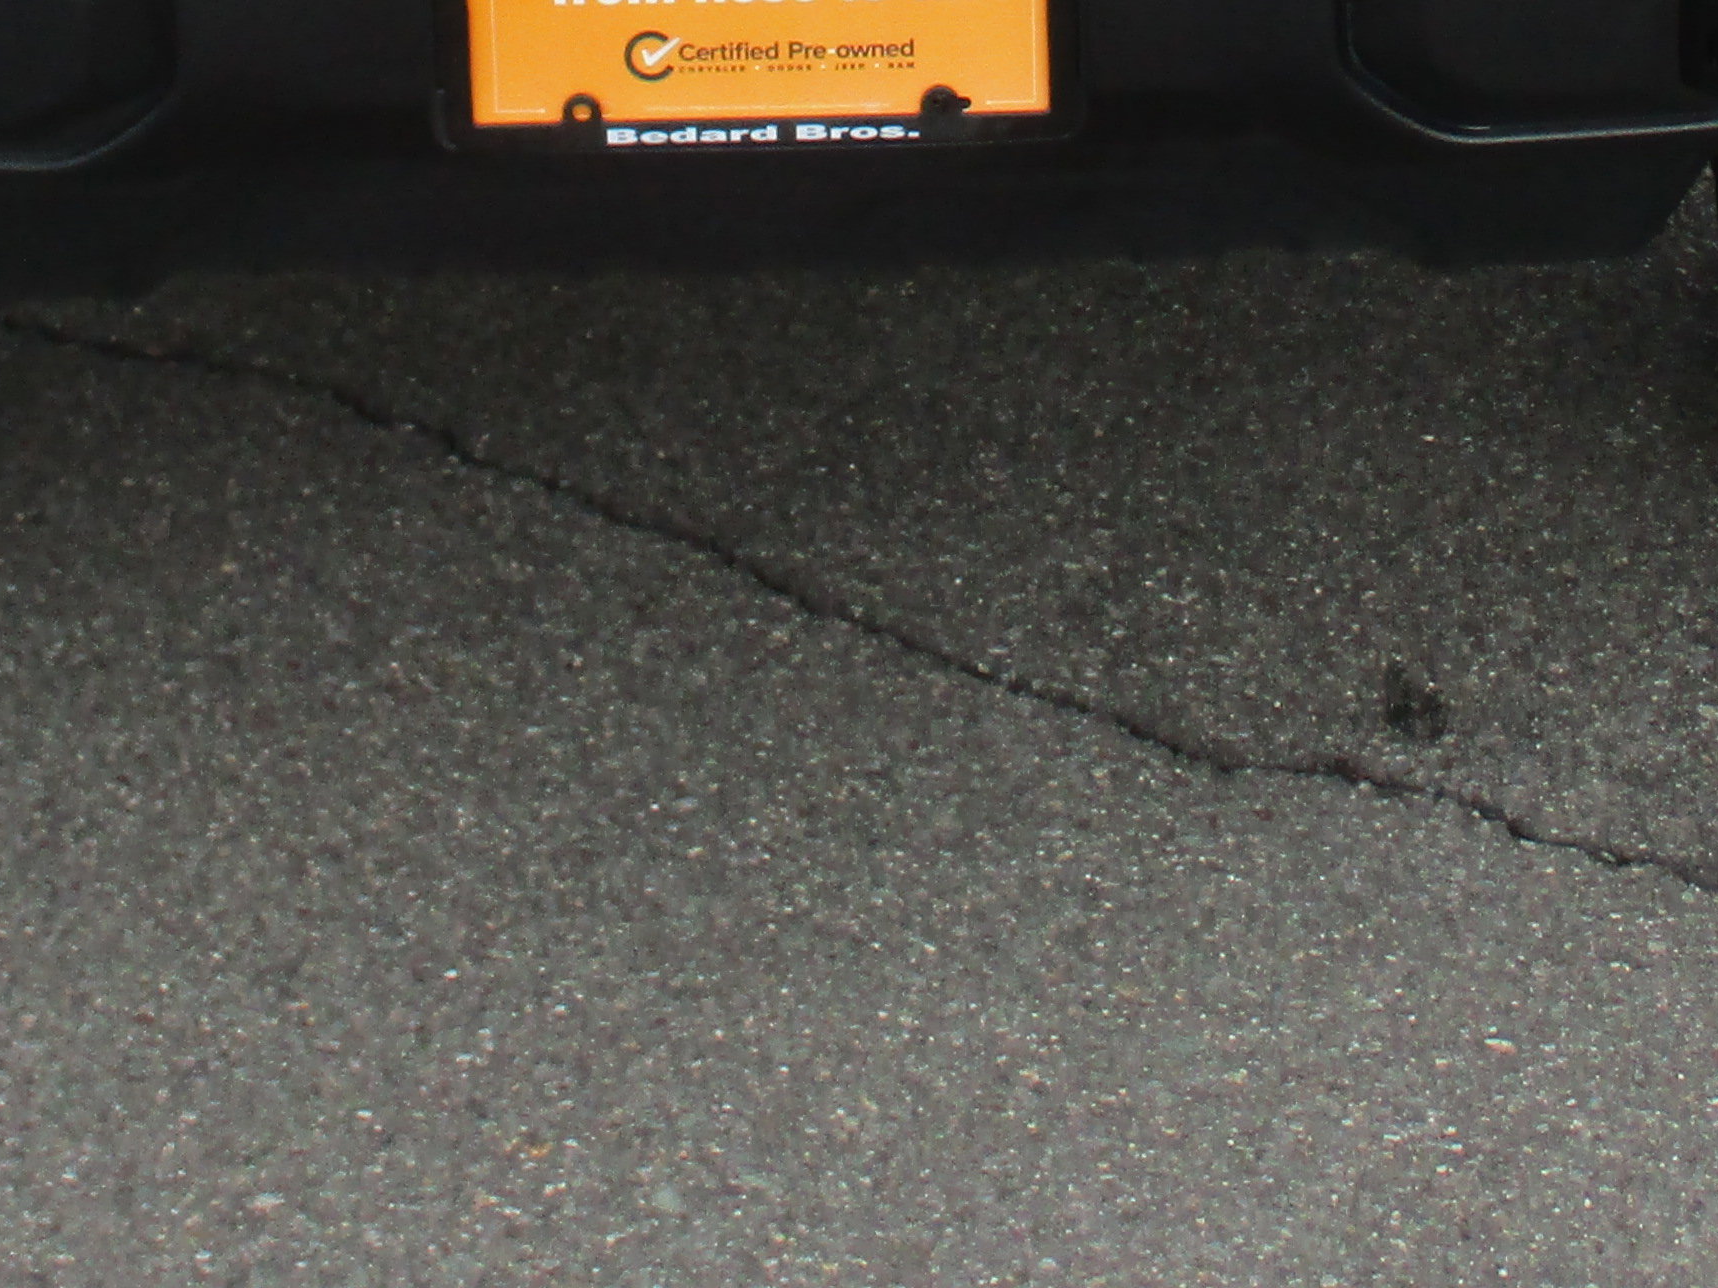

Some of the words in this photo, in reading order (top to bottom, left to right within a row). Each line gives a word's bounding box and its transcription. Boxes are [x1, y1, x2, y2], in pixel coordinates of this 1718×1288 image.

[678, 41, 780, 62] Certified
[788, 38, 915, 59] Pre-owned
[676, 64, 747, 74] CHRYSLER
[767, 63, 813, 72] DODGE
[834, 62, 866, 71] JEEP
[887, 61, 916, 69] RAM
[606, 124, 779, 145] Bedard
[795, 123, 921, 141] Bros.
